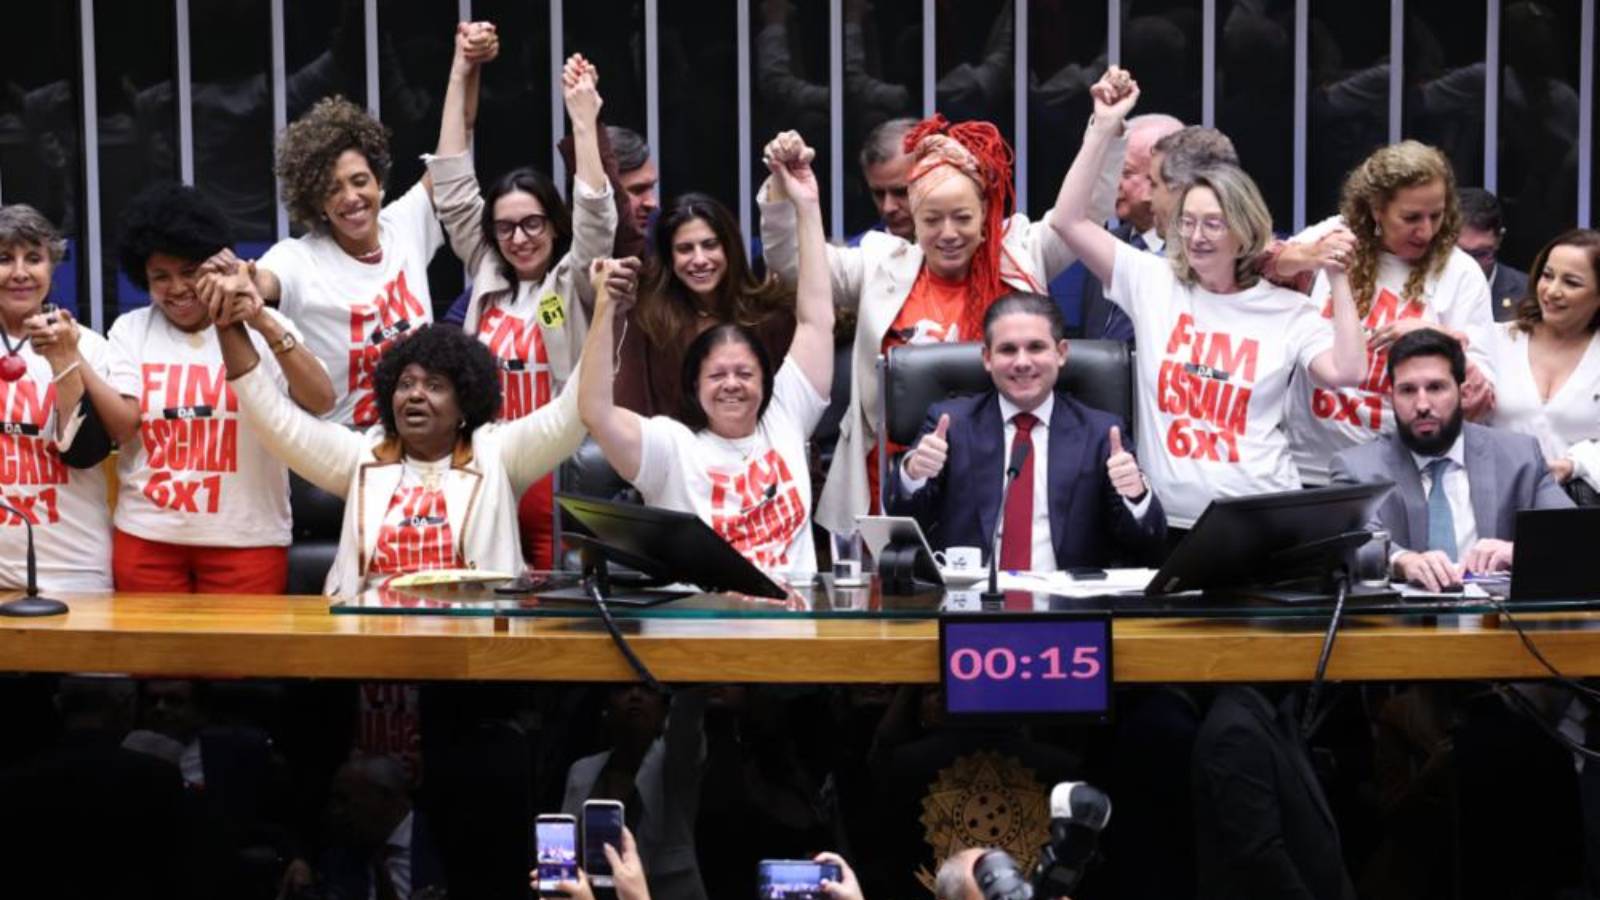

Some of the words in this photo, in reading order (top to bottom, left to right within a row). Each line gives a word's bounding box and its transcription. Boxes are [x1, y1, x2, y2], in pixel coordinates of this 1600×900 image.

[1166, 313, 1260, 382] FIM
[141, 364, 238, 413] FIM
[1157, 360, 1253, 436] ESCALA
[4, 423, 23, 434] DA
[178, 408, 196, 418] DA
[1166, 419, 1240, 463] 6x1
[144, 471, 221, 513] 6x1
[950, 646, 1101, 680] 00:15
